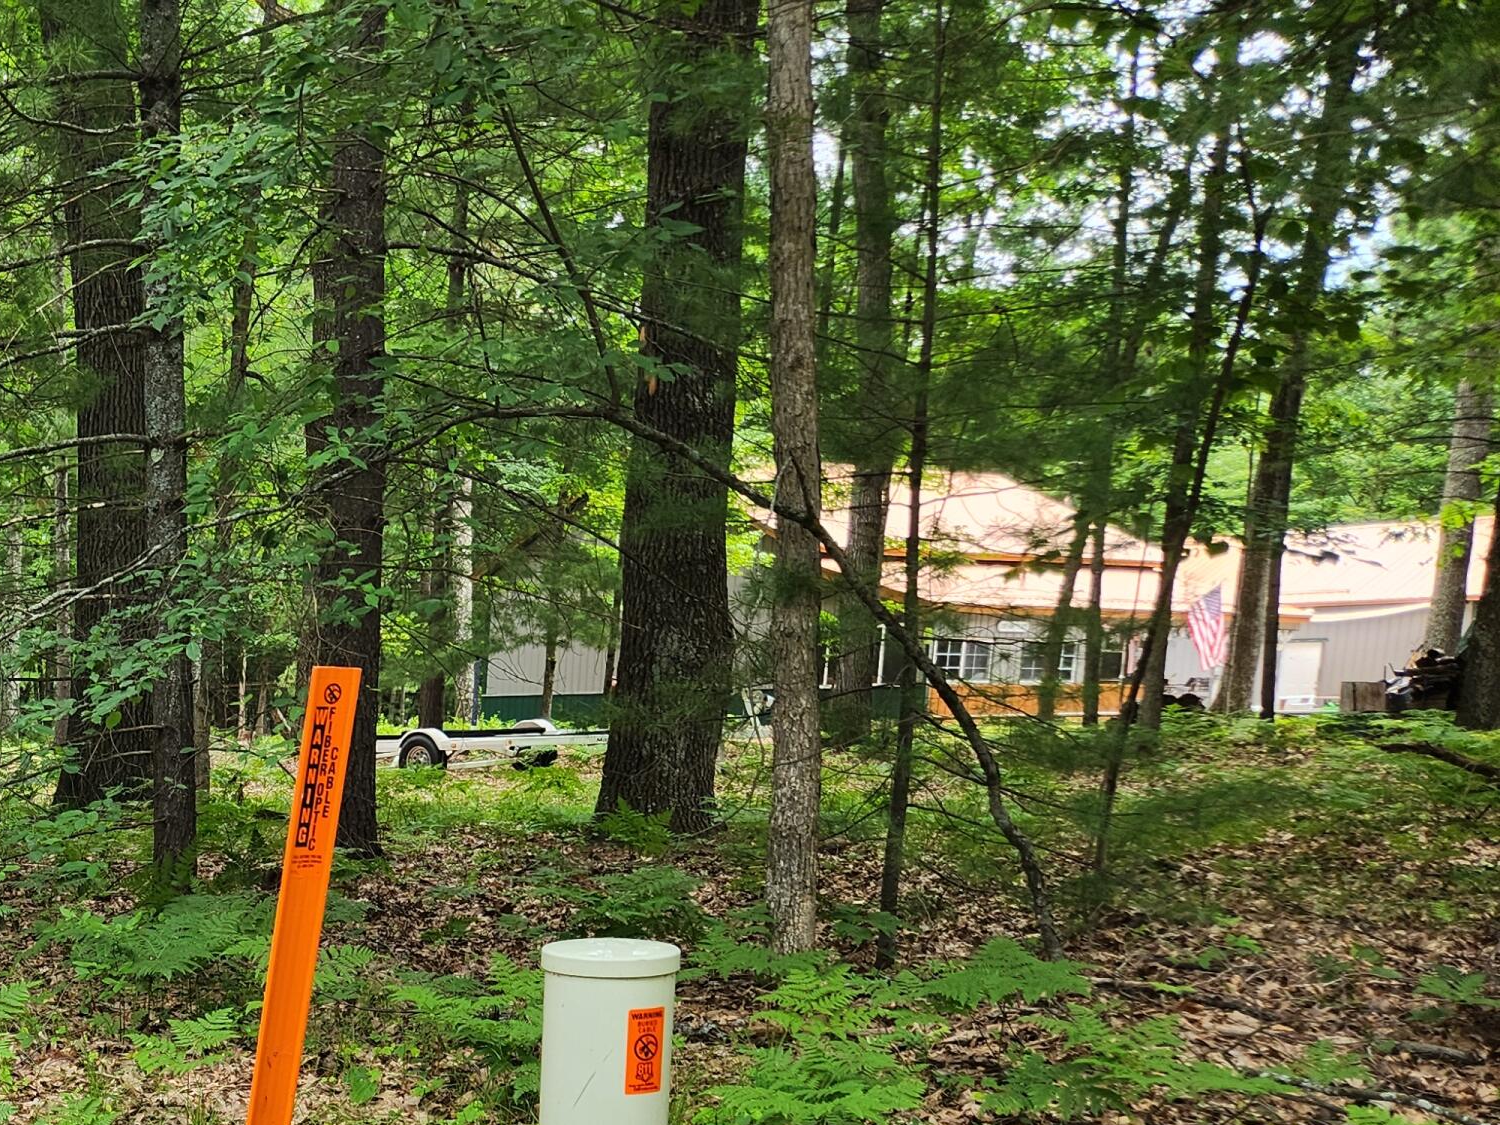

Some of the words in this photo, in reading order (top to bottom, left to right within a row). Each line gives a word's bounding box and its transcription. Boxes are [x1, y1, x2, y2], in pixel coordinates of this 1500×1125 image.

[298, 708, 328, 843] WARNING
[320, 707, 336, 776] FIBER
[322, 747, 339, 818] CABLE
[308, 783, 324, 851] OPTIC
[631, 1011, 662, 1020] WARNING
[637, 1062, 652, 1076] 811
